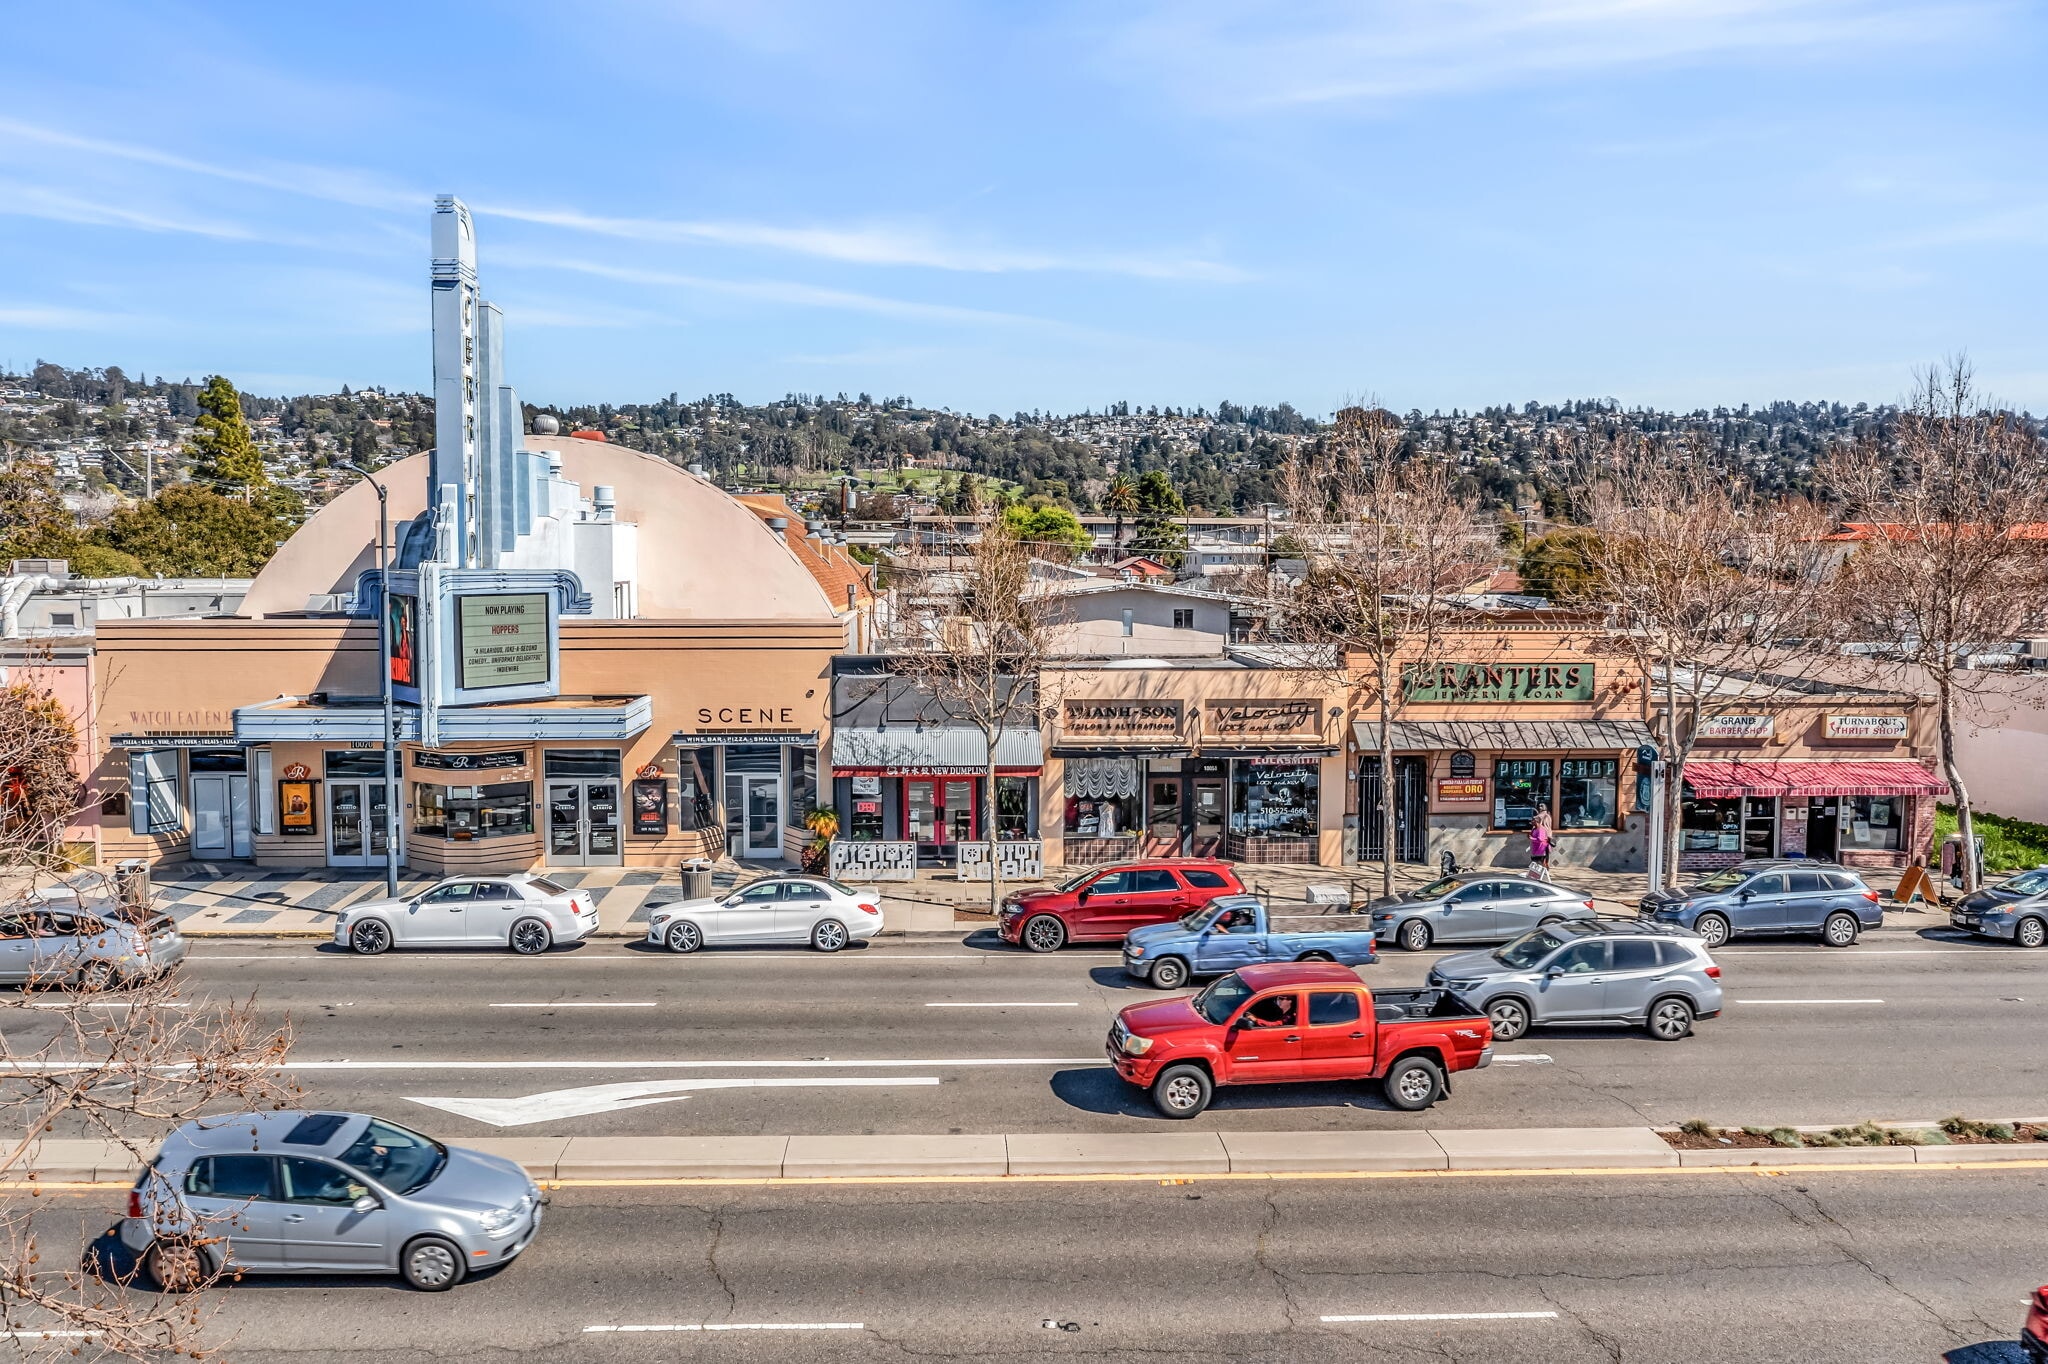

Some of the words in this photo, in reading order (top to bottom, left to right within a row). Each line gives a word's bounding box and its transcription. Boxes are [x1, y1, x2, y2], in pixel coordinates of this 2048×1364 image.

[485, 606, 499, 615] NOW
[501, 605, 525, 614] PLAYING
[491, 624, 520, 634] HOPPERS
[390, 656, 411, 683] RIDE!
[1508, 691, 1516, 699] &
[1527, 690, 1564, 699] LOAN
[130, 711, 172, 725] WATCH
[177, 711, 201, 725] EAT
[205, 711, 231, 725] ENJ
[698, 708, 793, 724] SCENE
[1216, 702, 1317, 727] Velocity
[1721, 716, 1755, 725] GRAND
[1839, 717, 1897, 726] TURNABOUT
[1070, 723, 1102, 731] TAILOR
[1115, 723, 1175, 731] ALTERATIONS
[1218, 723, 1247, 732] LOCK
[1249, 724, 1271, 732] and
[1709, 727, 1742, 735] BARBER
[1745, 727, 1768, 735] SHOP
[1837, 726, 1870, 735] THRIFT
[1873, 726, 1901, 735] SHOP
[932, 766, 949, 775] NEW
[950, 766, 988, 775] DUMPLING
[1500, 761, 1550, 776] PAWN
[1562, 761, 1615, 776] SHOP
[1257, 769, 1311, 783] Velocity
[1465, 785, 1483, 793] ORO
